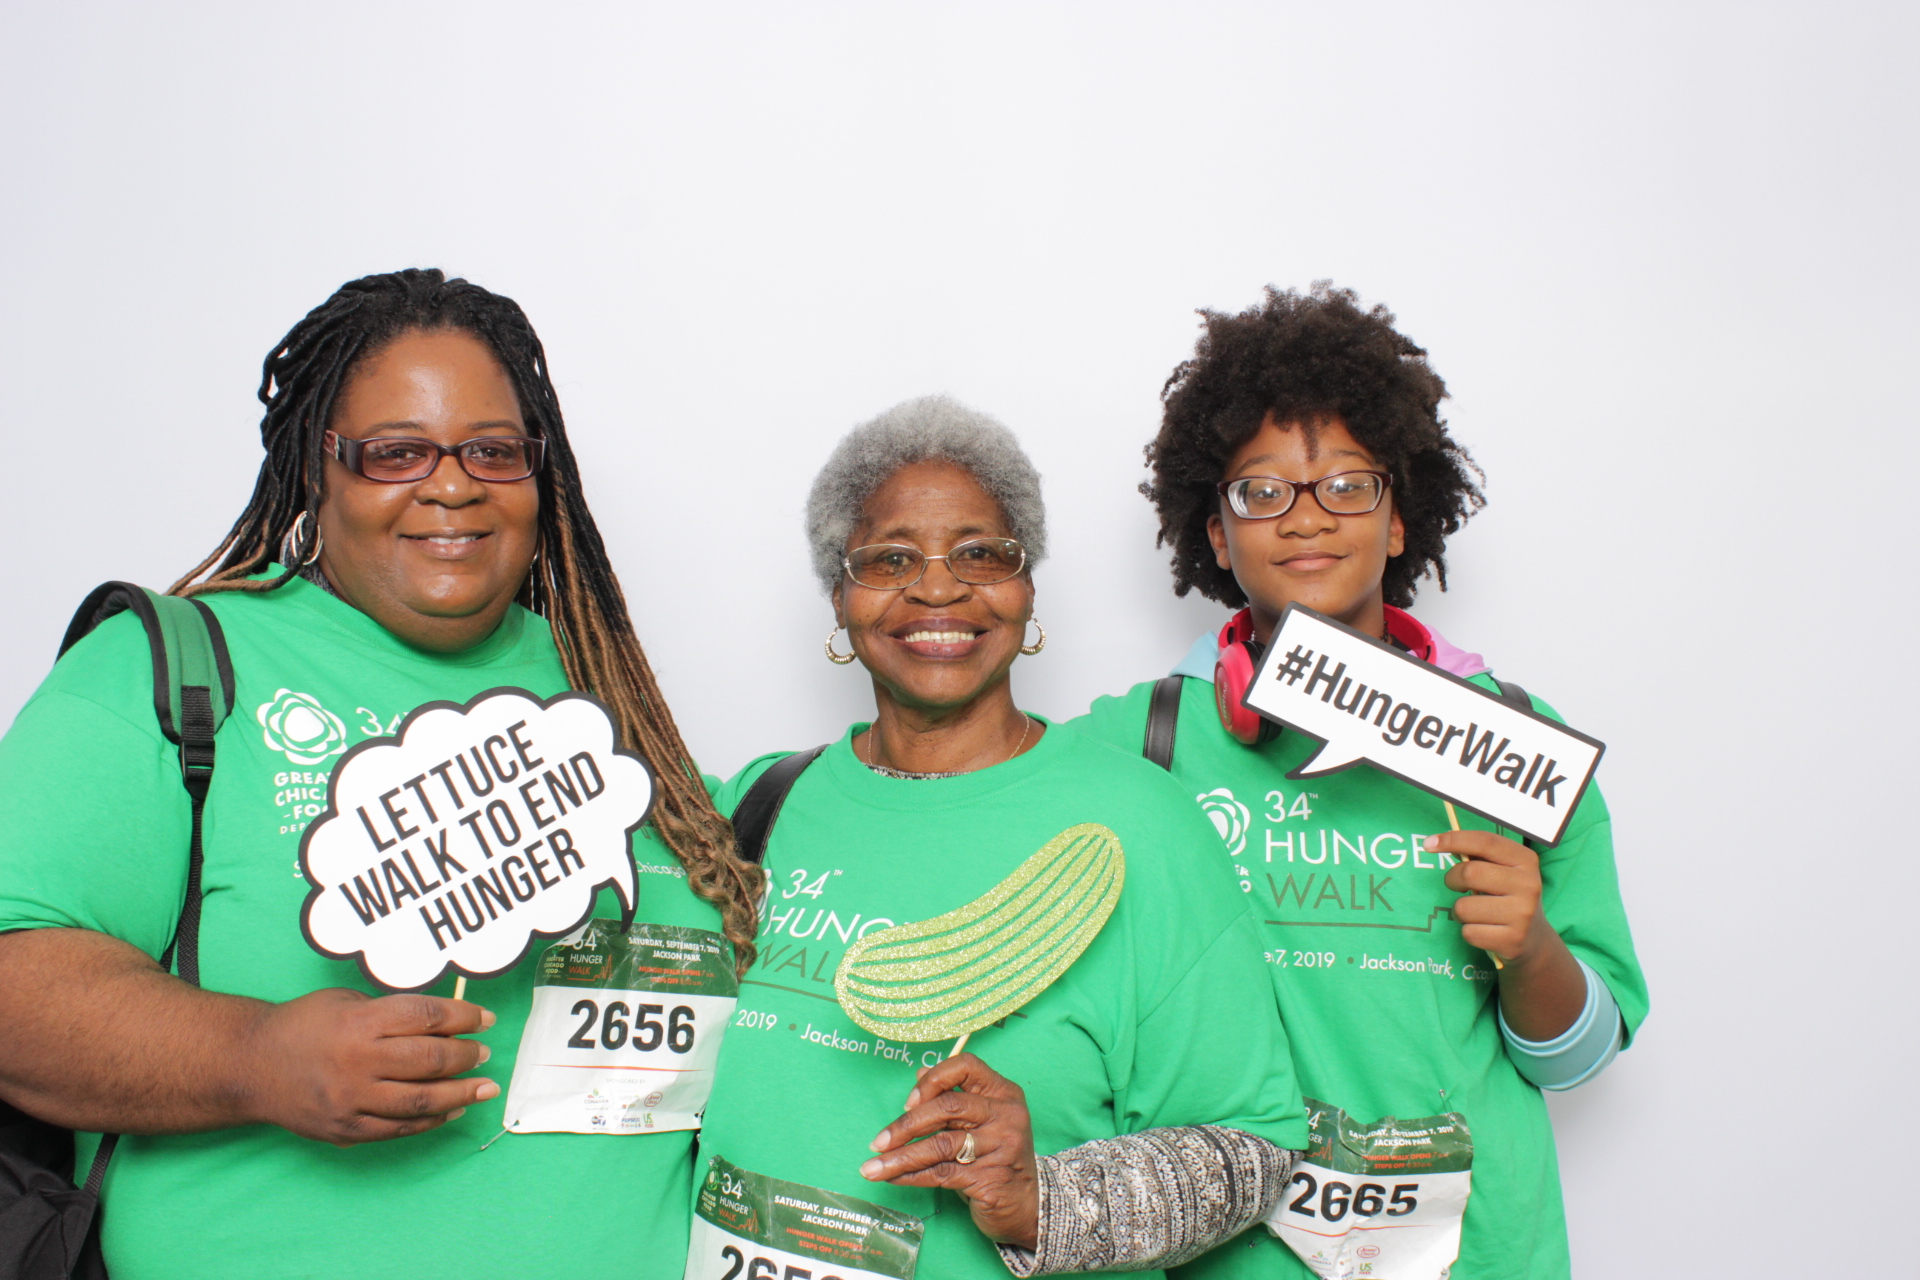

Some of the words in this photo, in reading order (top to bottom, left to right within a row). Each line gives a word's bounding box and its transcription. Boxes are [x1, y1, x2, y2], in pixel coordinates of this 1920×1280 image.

[1275, 644, 1568, 808] #HungerWalk
[274, 771, 331, 787] GREA
[356, 719, 544, 853] LETTUCE
[339, 829, 468, 927] WALK
[459, 798, 522, 860] TO
[518, 750, 606, 831] END
[418, 828, 586, 951] HUNGER
[1265, 871, 1395, 912] WALK
[762, 904, 910, 944] HUN
[628, 937, 665, 949] SATURDAY,
[569, 953, 603, 965] HUNGER
[652, 950, 682, 961] JACKSON
[683, 952, 702, 962] PARK
[755, 942, 836, 985] WAL
[1293, 951, 1336, 968] 2019
[1359, 953, 1426, 973] Jackson
[1428, 957, 1456, 980] Park,
[568, 965, 591, 976] WALK
[567, 999, 696, 1054] 2656
[735, 1009, 777, 1032] 2019
[800, 1023, 869, 1055] Jackson
[874, 1039, 914, 1068] Park,
[1438, 1126, 1454, 1134] 2019
[1373, 1138, 1412, 1147] JACKSON
[1412, 1137, 1432, 1145] PARK
[720, 1195, 749, 1216] HUNGER
[1289, 1171, 1420, 1223] 2665
[719, 1207, 737, 1222] WALK
[774, 1194, 820, 1214] SATURDAY,
[822, 1206, 872, 1227] SEPTEMBER
[883, 1222, 905, 1235] 2019
[802, 1213, 843, 1231] JACKSON
[844, 1223, 869, 1236] PARK
[786, 1227, 815, 1241] HUNGER
[816, 1234, 837, 1246] WALK
[798, 1240, 818, 1251] STEPS
[819, 1245, 833, 1253] OFF
